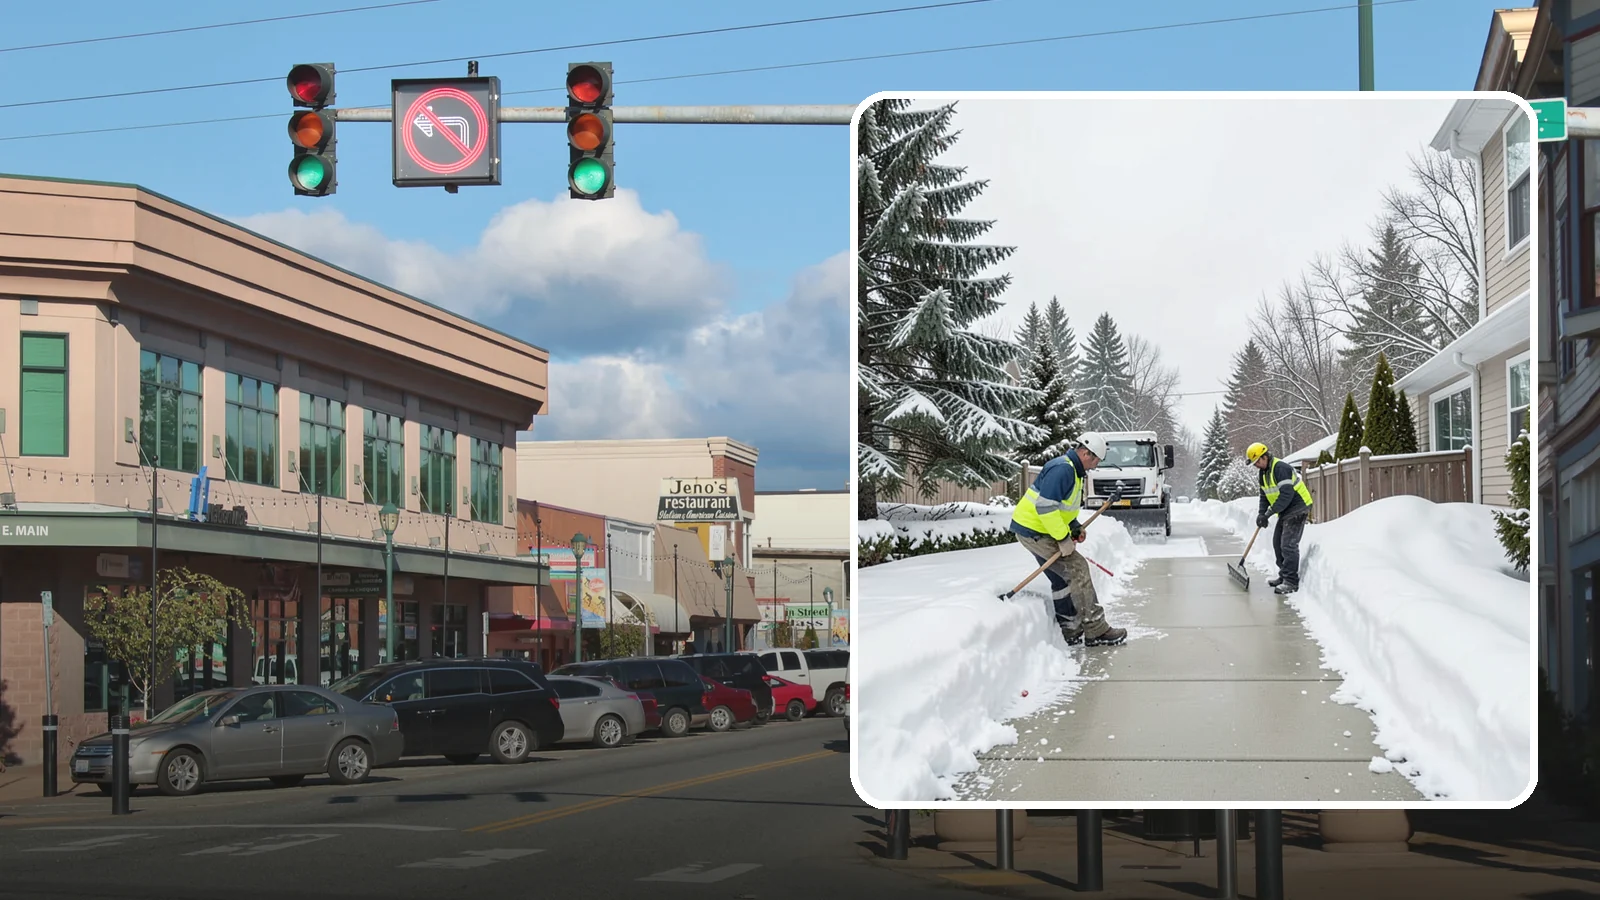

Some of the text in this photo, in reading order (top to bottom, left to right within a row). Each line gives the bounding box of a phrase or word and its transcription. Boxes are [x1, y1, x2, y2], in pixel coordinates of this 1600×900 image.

[670, 480, 727, 494] Jeno's
[665, 496, 731, 509] restaurant
[659, 510, 682, 519] Italian
[686, 509, 715, 519] American
[715, 509, 737, 519] Cuisine
[2, 525, 49, 536] E. MAIN
[797, 607, 828, 617] Street
